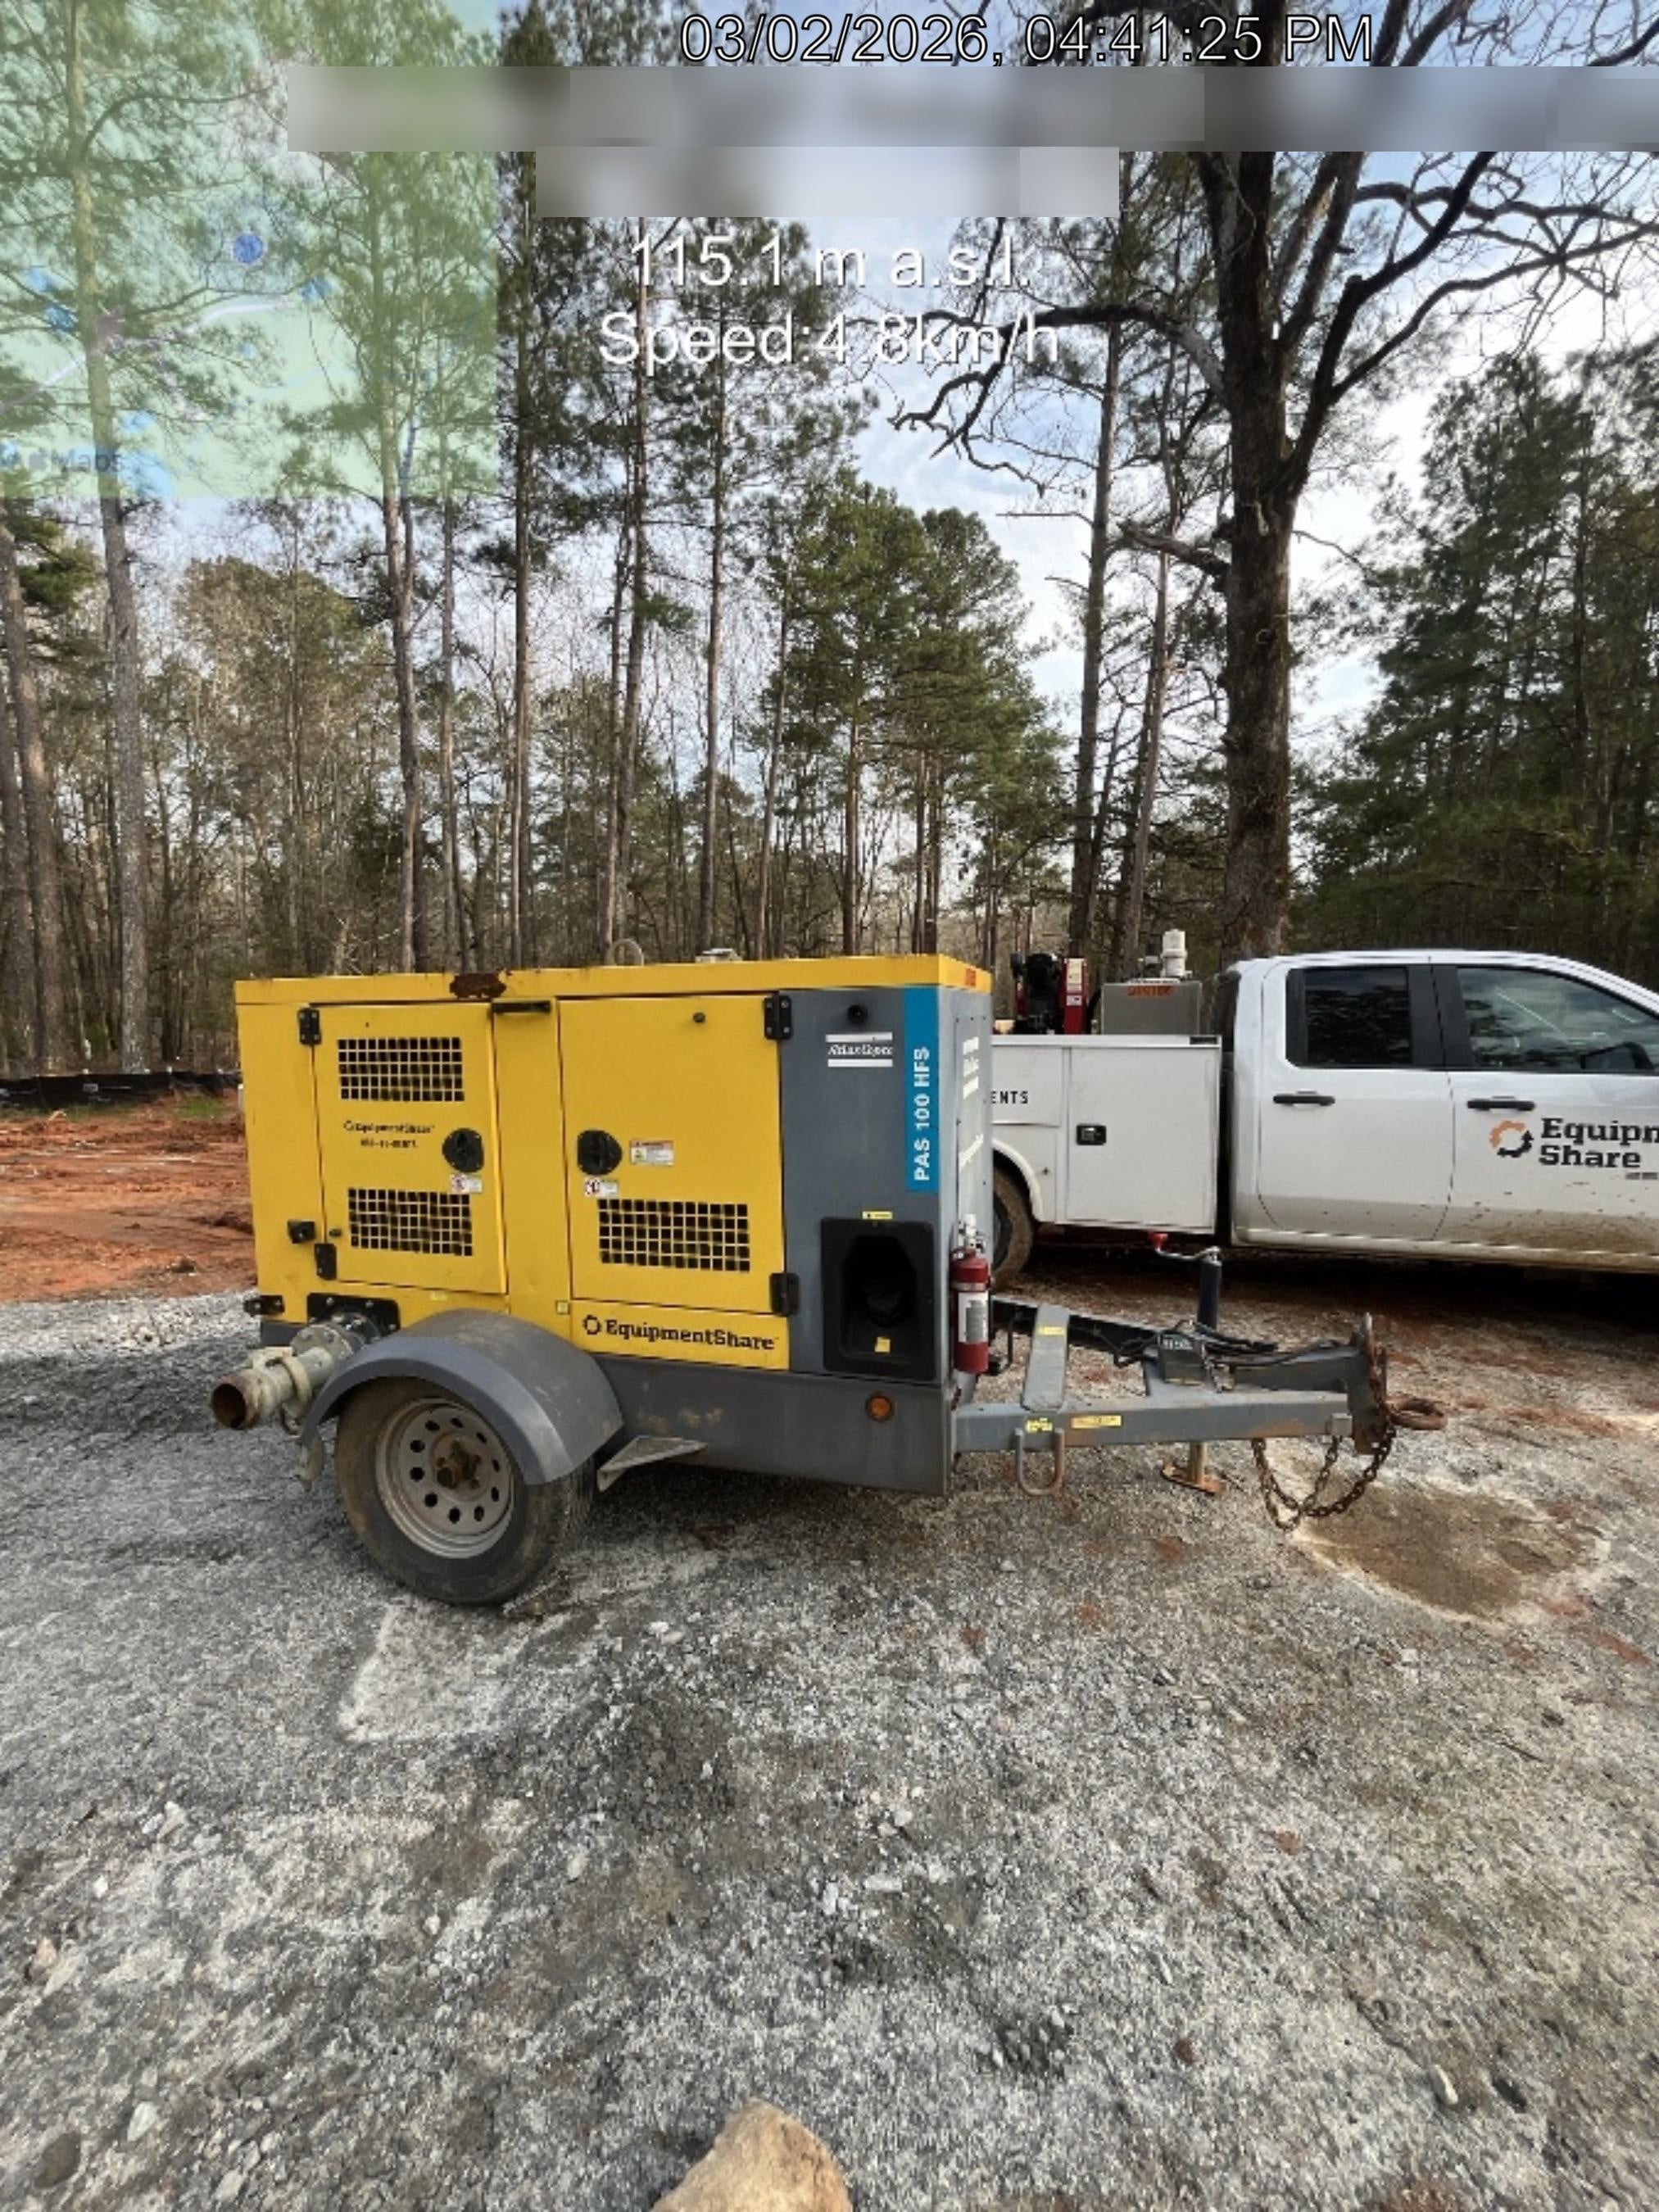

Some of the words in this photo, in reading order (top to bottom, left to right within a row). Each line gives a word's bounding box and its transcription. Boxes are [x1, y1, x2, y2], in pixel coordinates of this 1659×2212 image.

[913, 1046, 931, 1087] HFS
[913, 1093, 931, 1131] 100
[913, 1137, 931, 1181] PAS
[1538, 1144, 1641, 1168] Share
[605, 1318, 775, 1351] EquipmentShare
